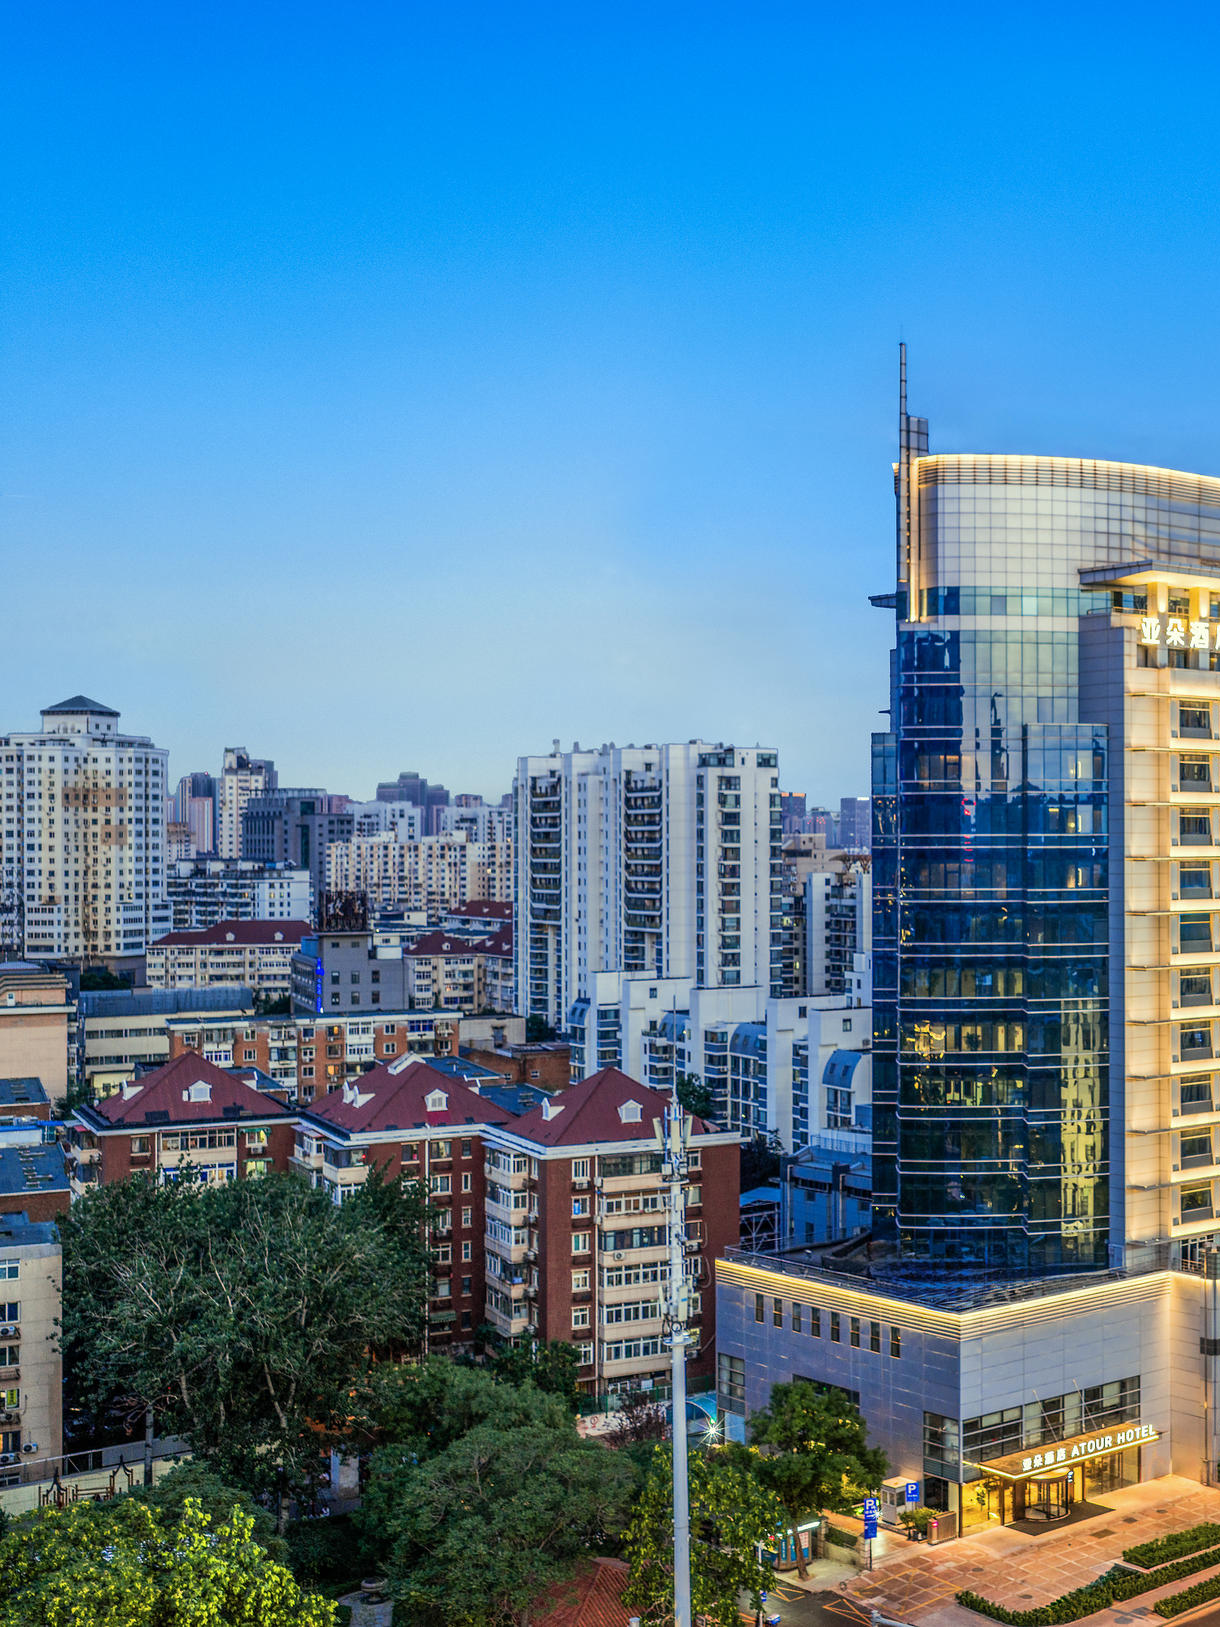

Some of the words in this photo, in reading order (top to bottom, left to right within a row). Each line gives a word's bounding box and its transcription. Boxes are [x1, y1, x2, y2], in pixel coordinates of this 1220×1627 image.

[1071, 1435, 1113, 1458] ATOUR
[1117, 1424, 1156, 1444] HOTEL
[908, 1484, 916, 1494] P
[866, 1499, 874, 1510] P
